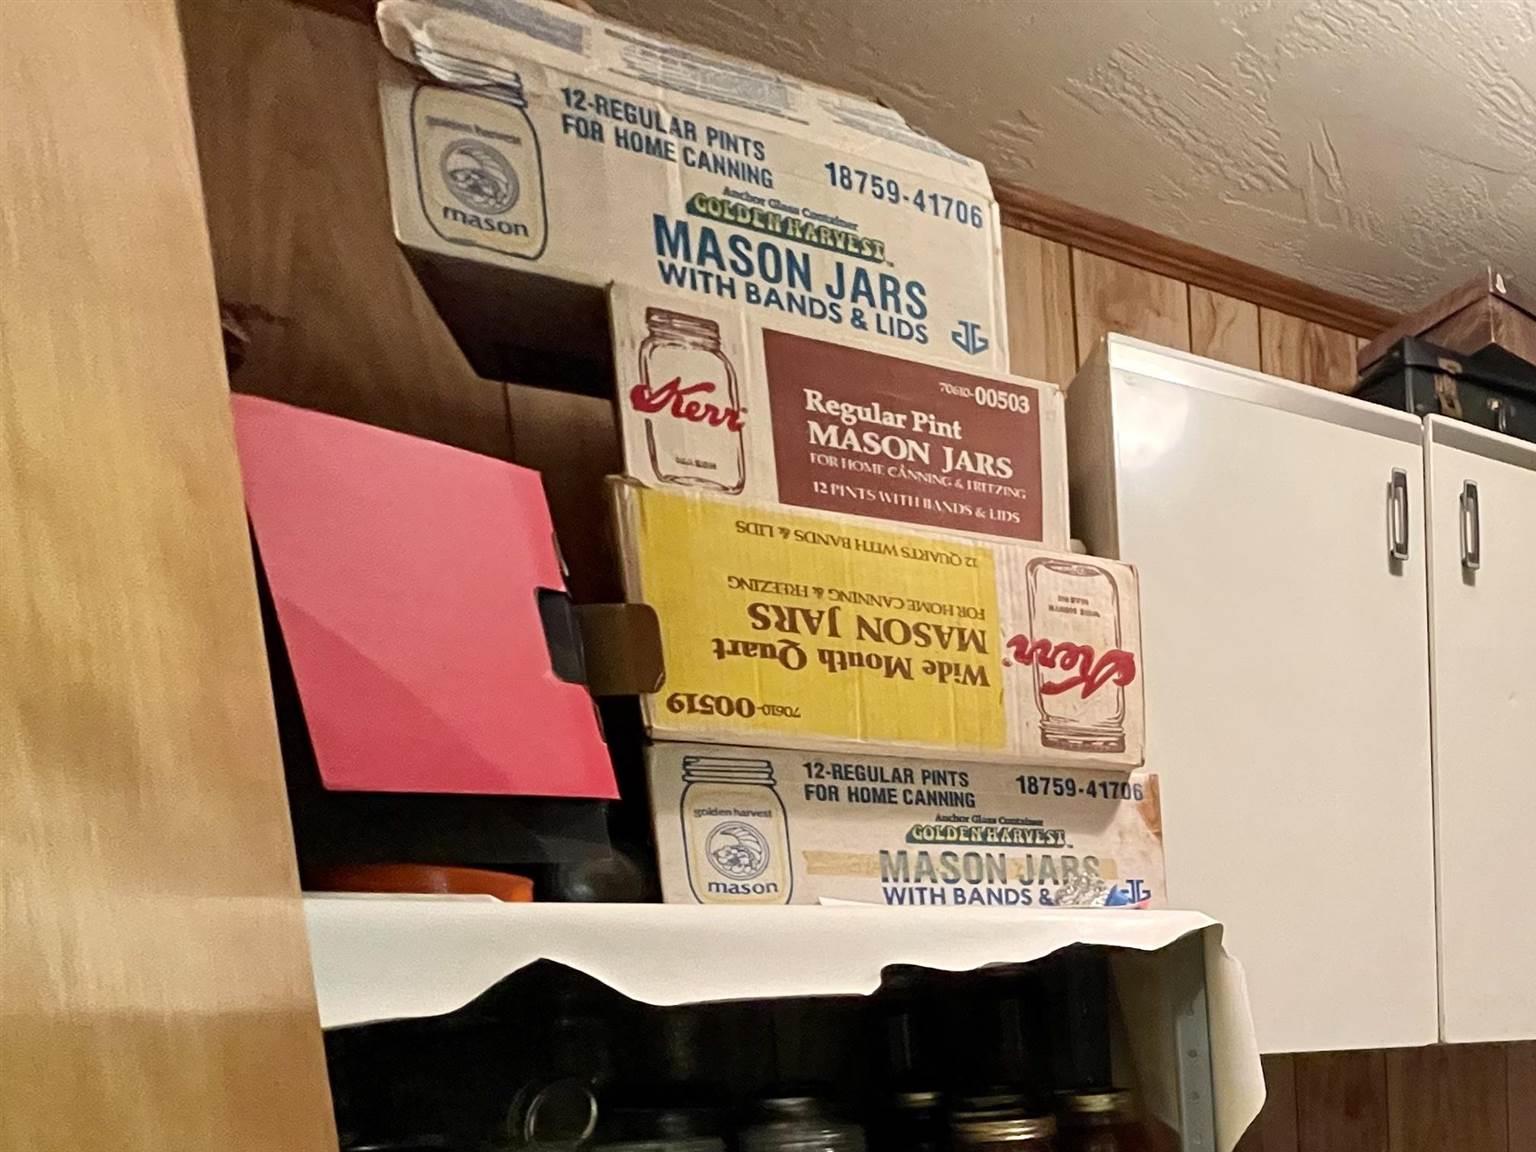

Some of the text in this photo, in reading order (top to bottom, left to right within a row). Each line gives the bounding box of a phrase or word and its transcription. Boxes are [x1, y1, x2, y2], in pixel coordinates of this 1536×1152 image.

[561, 87, 697, 142] 12-REGULAR
[706, 126, 766, 161] PINTS
[561, 114, 605, 143] FOR
[615, 126, 678, 162] HOME
[683, 146, 774, 189] CANNING
[723, 186, 765, 206] Anchor
[801, 208, 858, 231] Container
[824, 162, 983, 229] 18759-41706
[442, 206, 529, 237] mason
[692, 192, 886, 261] GOLDEN HARVEST
[652, 213, 928, 320] MASON JARS
[657, 259, 929, 345] WITH BANDS & LIDS
[630, 376, 744, 432] Kerr
[803, 388, 963, 440] Regular Pint
[807, 420, 1014, 479] MASON JARS
[810, 452, 1027, 499] FOR HOME CANNING & FREEZING
[813, 481, 1021, 524] 12 PINTS WITH BANDS & LIDS
[735, 520, 978, 568] 12 QUARTS WITH BANDS & LIDS
[727, 575, 985, 620] FOR HOME CANNING & FREEZING
[747, 602, 989, 654] MASON JARS
[712, 637, 991, 687] Wide Mouth Quart
[1006, 634, 1136, 699] Kerr
[666, 691, 801, 718] 70610-00519
[802, 761, 969, 788] 12-REGULAR PINTS
[804, 785, 976, 809] FOR HOME CANNING
[1015, 775, 1144, 801] 18759-41706
[693, 807, 772, 818] golden harvest
[911, 824, 1066, 846] GOLDEN HARVEST
[934, 813, 1044, 827] Anchor Glass Container
[707, 881, 778, 895] mason
[879, 849, 1008, 884] MASON
[882, 886, 1054, 906] WITH BANDS &
